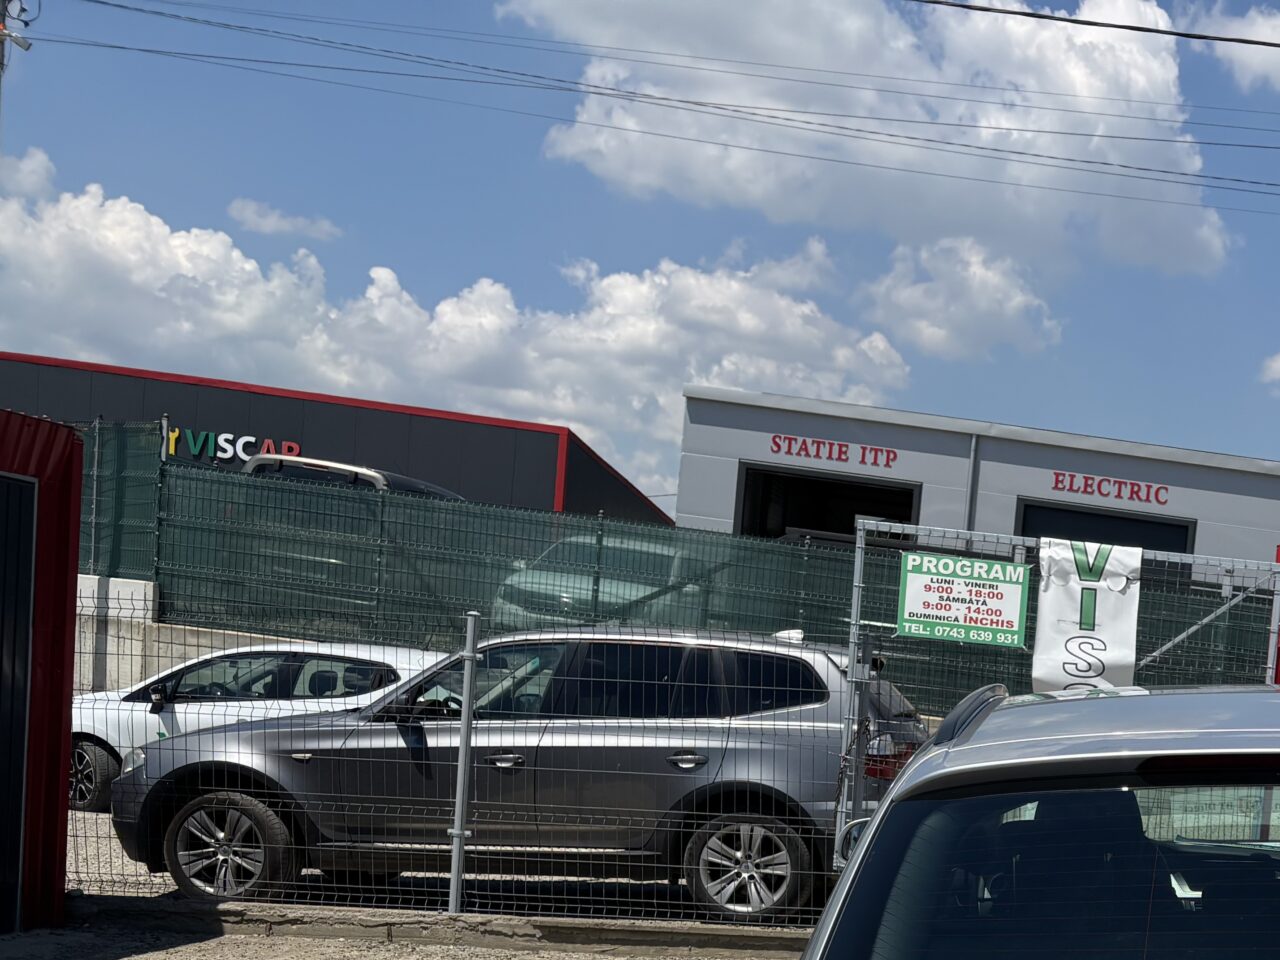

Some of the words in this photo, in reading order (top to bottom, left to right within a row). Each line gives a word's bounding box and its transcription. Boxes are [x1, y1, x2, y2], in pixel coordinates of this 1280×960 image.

[770, 435, 849, 462] STATIE
[859, 446, 897, 468] ITP
[1052, 471, 1168, 505] ELECTRIC
[907, 555, 1024, 582] PROGRAM
[923, 584, 953, 595] 9:00
[966, 589, 1004, 600] 18:00
[930, 577, 955, 586] LUNI
[963, 581, 999, 590] VINERI
[922, 601, 952, 612] 9:00
[965, 606, 1003, 617] 14:00
[1063, 541, 1113, 690] VIS
[903, 622, 930, 635] TEL:
[934, 627, 965, 639] 0743
[969, 630, 993, 642] 639
[996, 633, 1018, 644] 931
[963, 615, 1014, 629] ÎNCHIS
